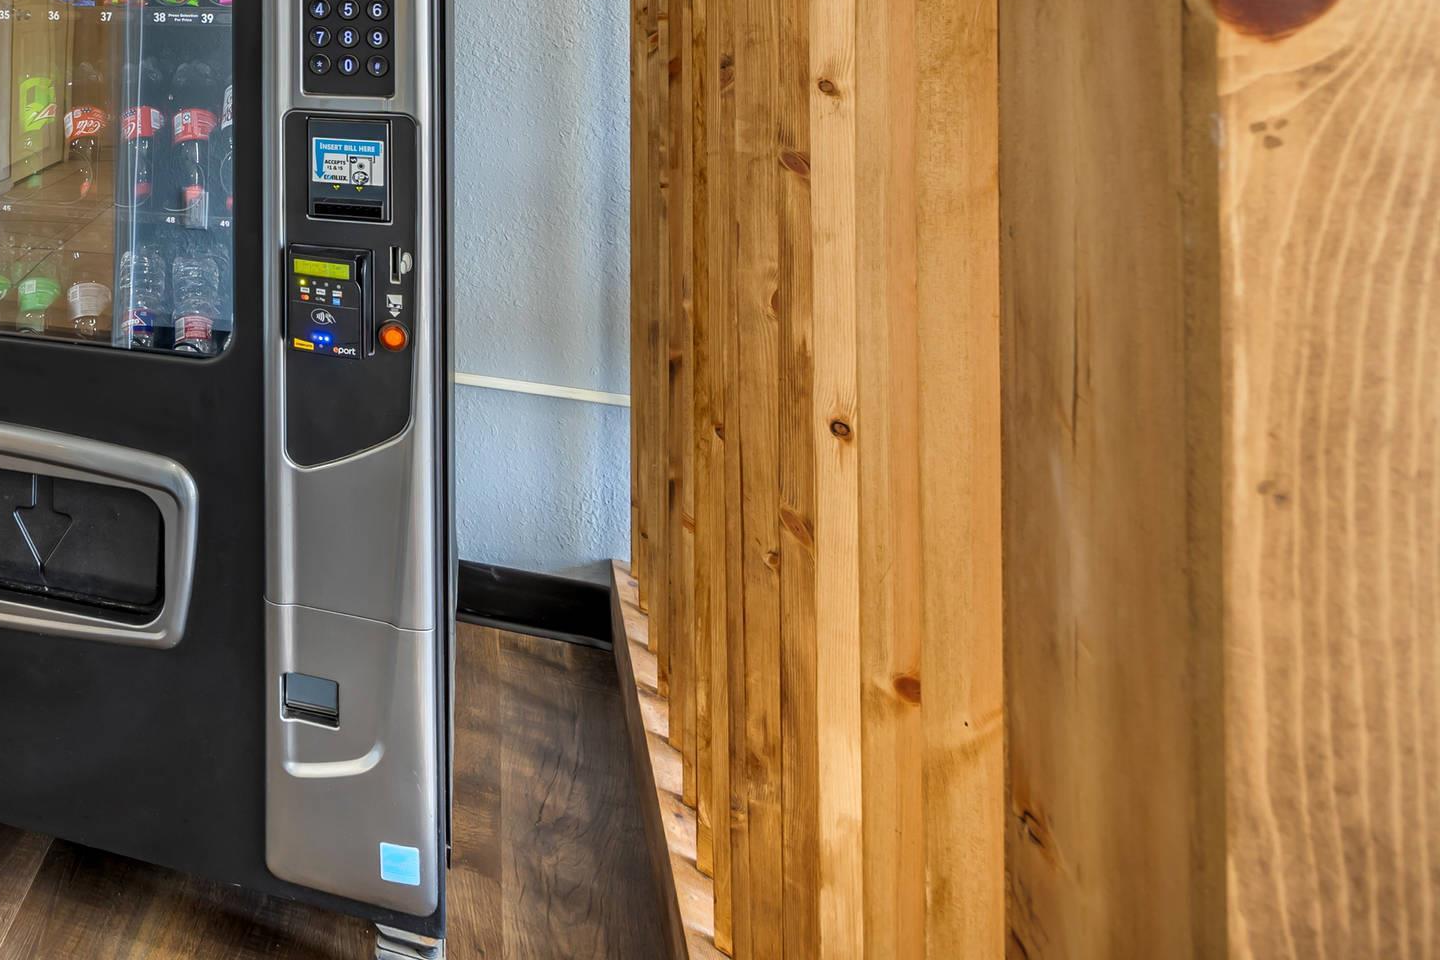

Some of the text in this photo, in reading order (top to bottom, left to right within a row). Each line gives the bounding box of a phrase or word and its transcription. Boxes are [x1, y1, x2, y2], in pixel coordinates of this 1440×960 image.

[315, 2, 382, 17] 4 5 6
[0, 10, 10, 20] 35
[48, 11, 60, 21] 36
[100, 12, 113, 22] 37
[153, 12, 166, 23] 38
[200, 13, 214, 24] 39
[316, 30, 383, 45] 7 8 9
[344, 59, 353, 72] 0
[319, 142, 375, 153] INSERT BILL HERE
[165, 216, 175, 224] 48
[332, 346, 357, 356] eport
